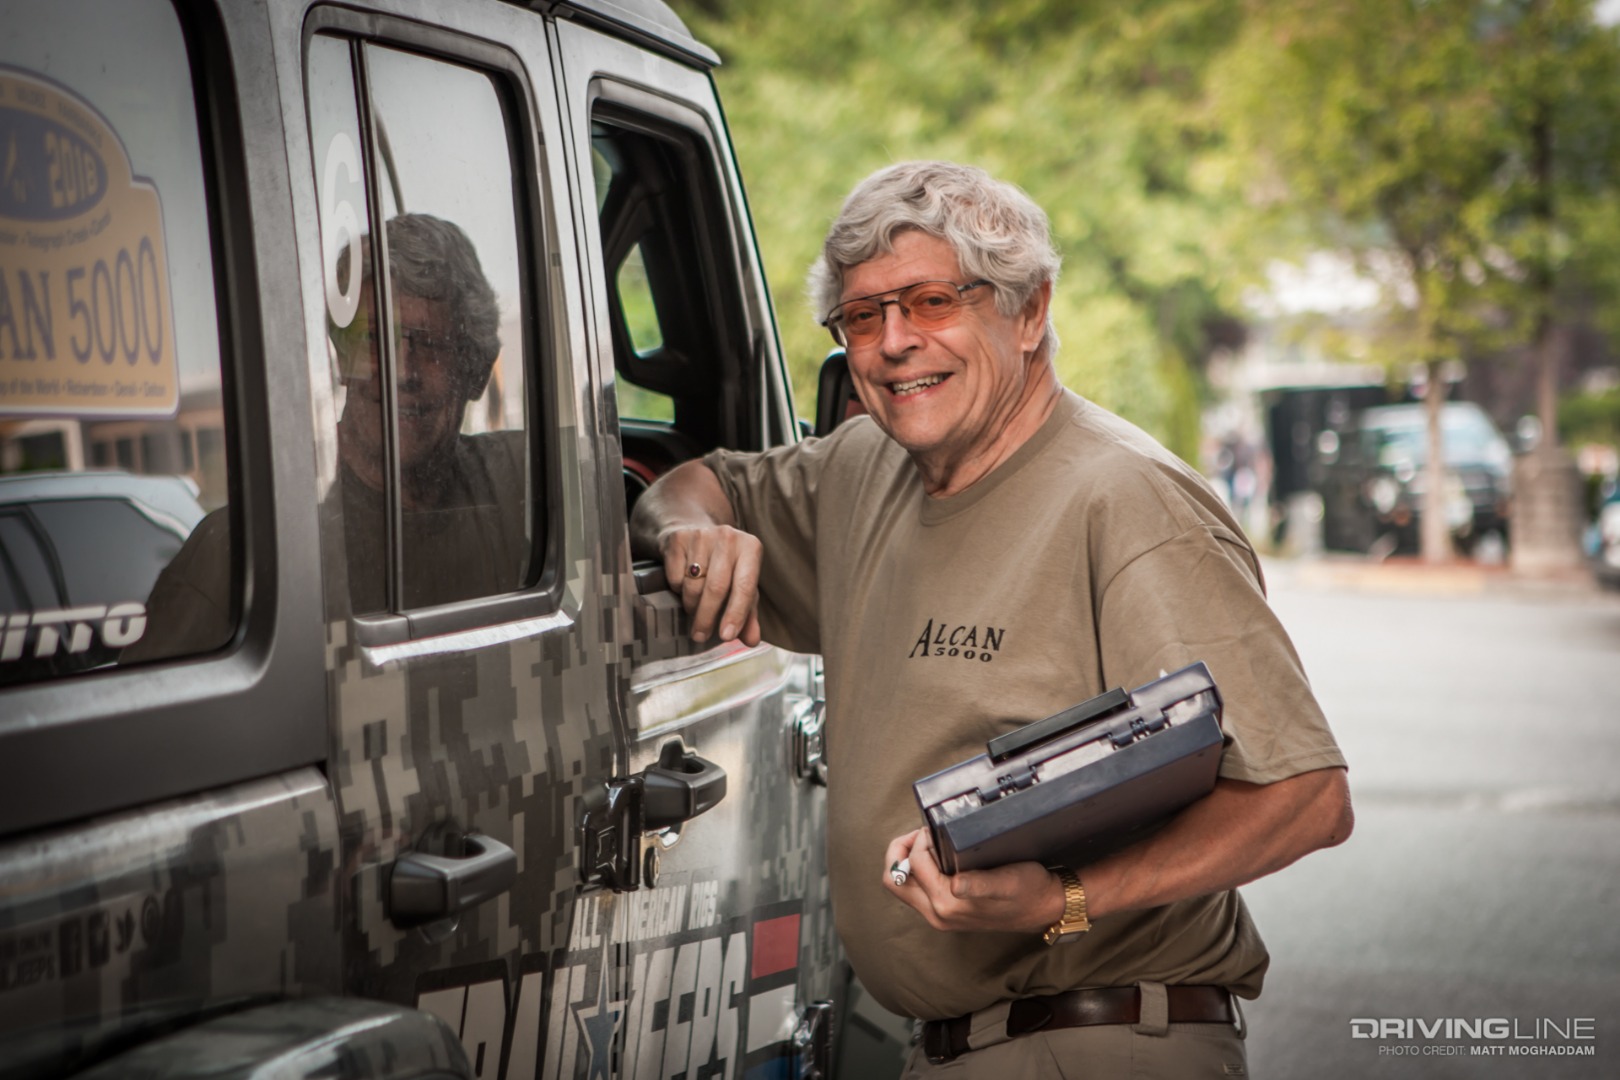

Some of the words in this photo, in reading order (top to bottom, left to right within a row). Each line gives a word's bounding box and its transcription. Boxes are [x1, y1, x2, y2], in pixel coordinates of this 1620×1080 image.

[45, 130, 98, 208] 2018
[323, 132, 362, 328] 6
[66, 236, 163, 366] 5000
[0, 603, 147, 661] ITTO
[909, 618, 1006, 658] ALCAN
[934, 647, 992, 662] 5000
[568, 896, 601, 952] ALL
[610, 885, 687, 945] AMERICAN
